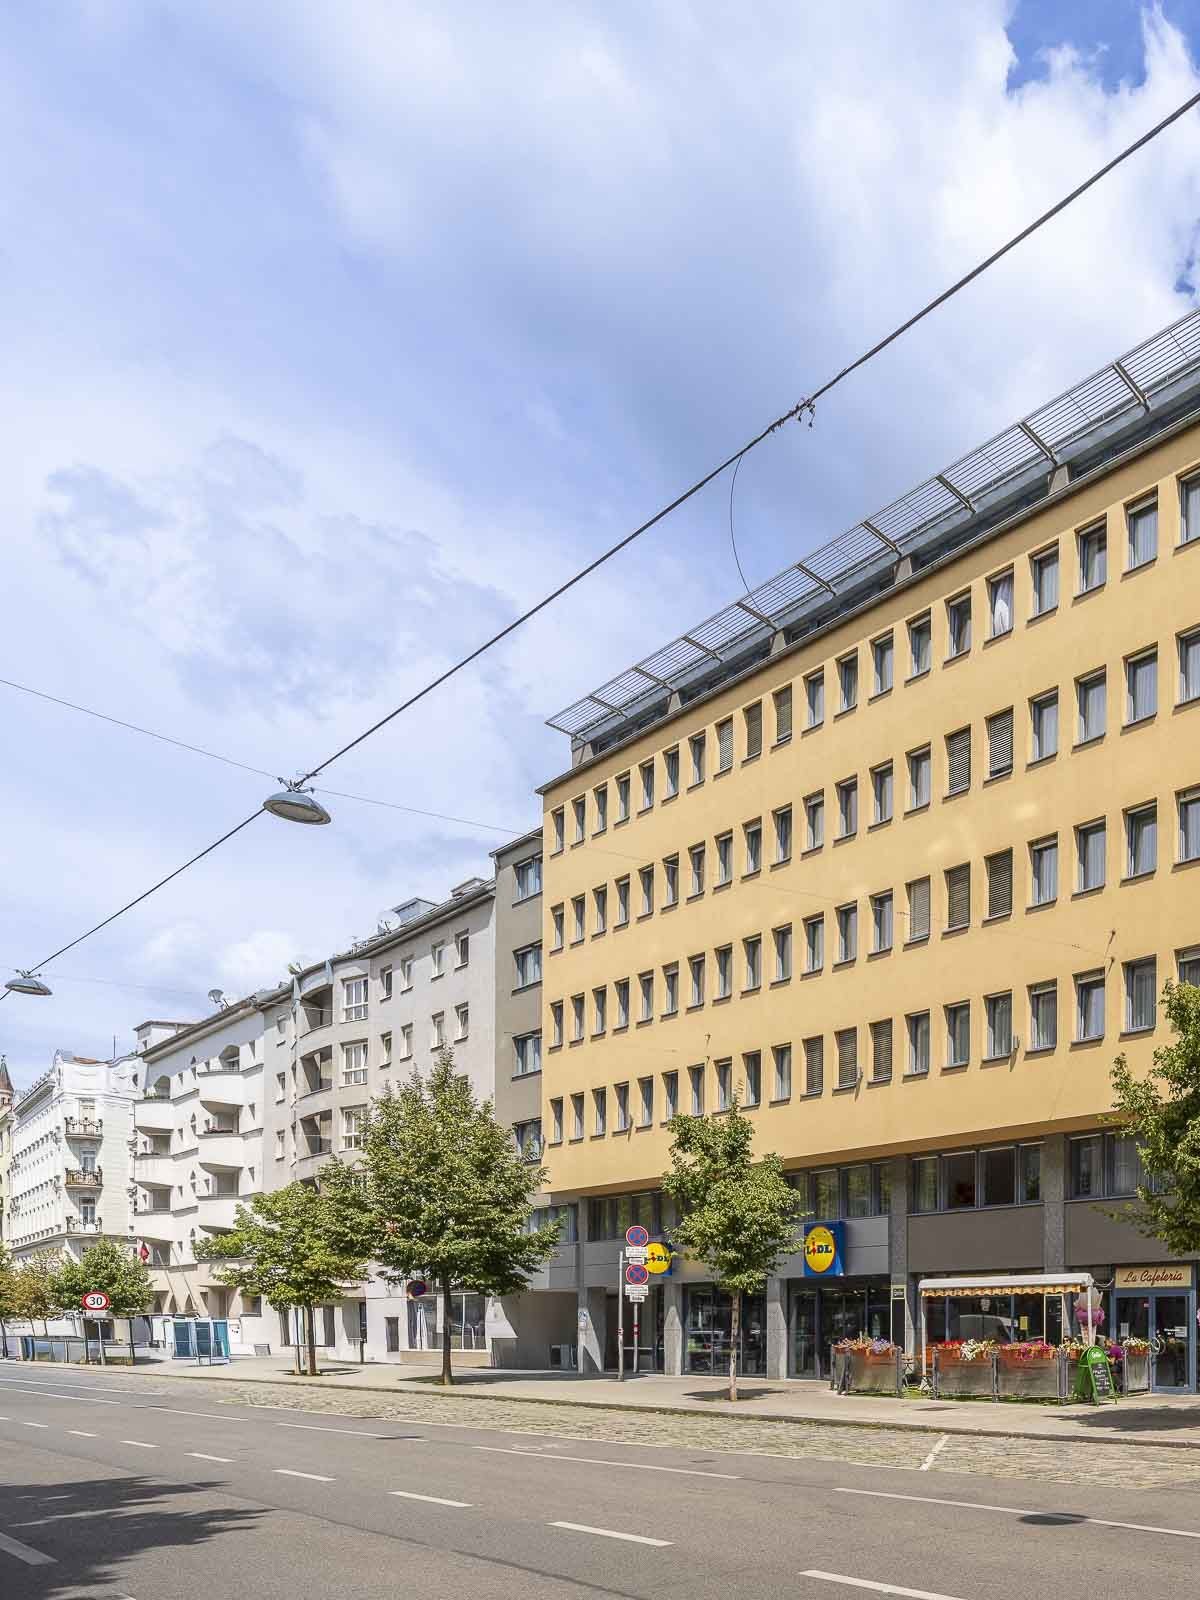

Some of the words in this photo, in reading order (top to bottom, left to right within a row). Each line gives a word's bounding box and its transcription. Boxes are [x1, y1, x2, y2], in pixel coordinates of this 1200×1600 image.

[1123, 1271, 1137, 1282] La
[1140, 1269, 1184, 1286] Cafeteria
[90, 1296, 102, 1306] 30
